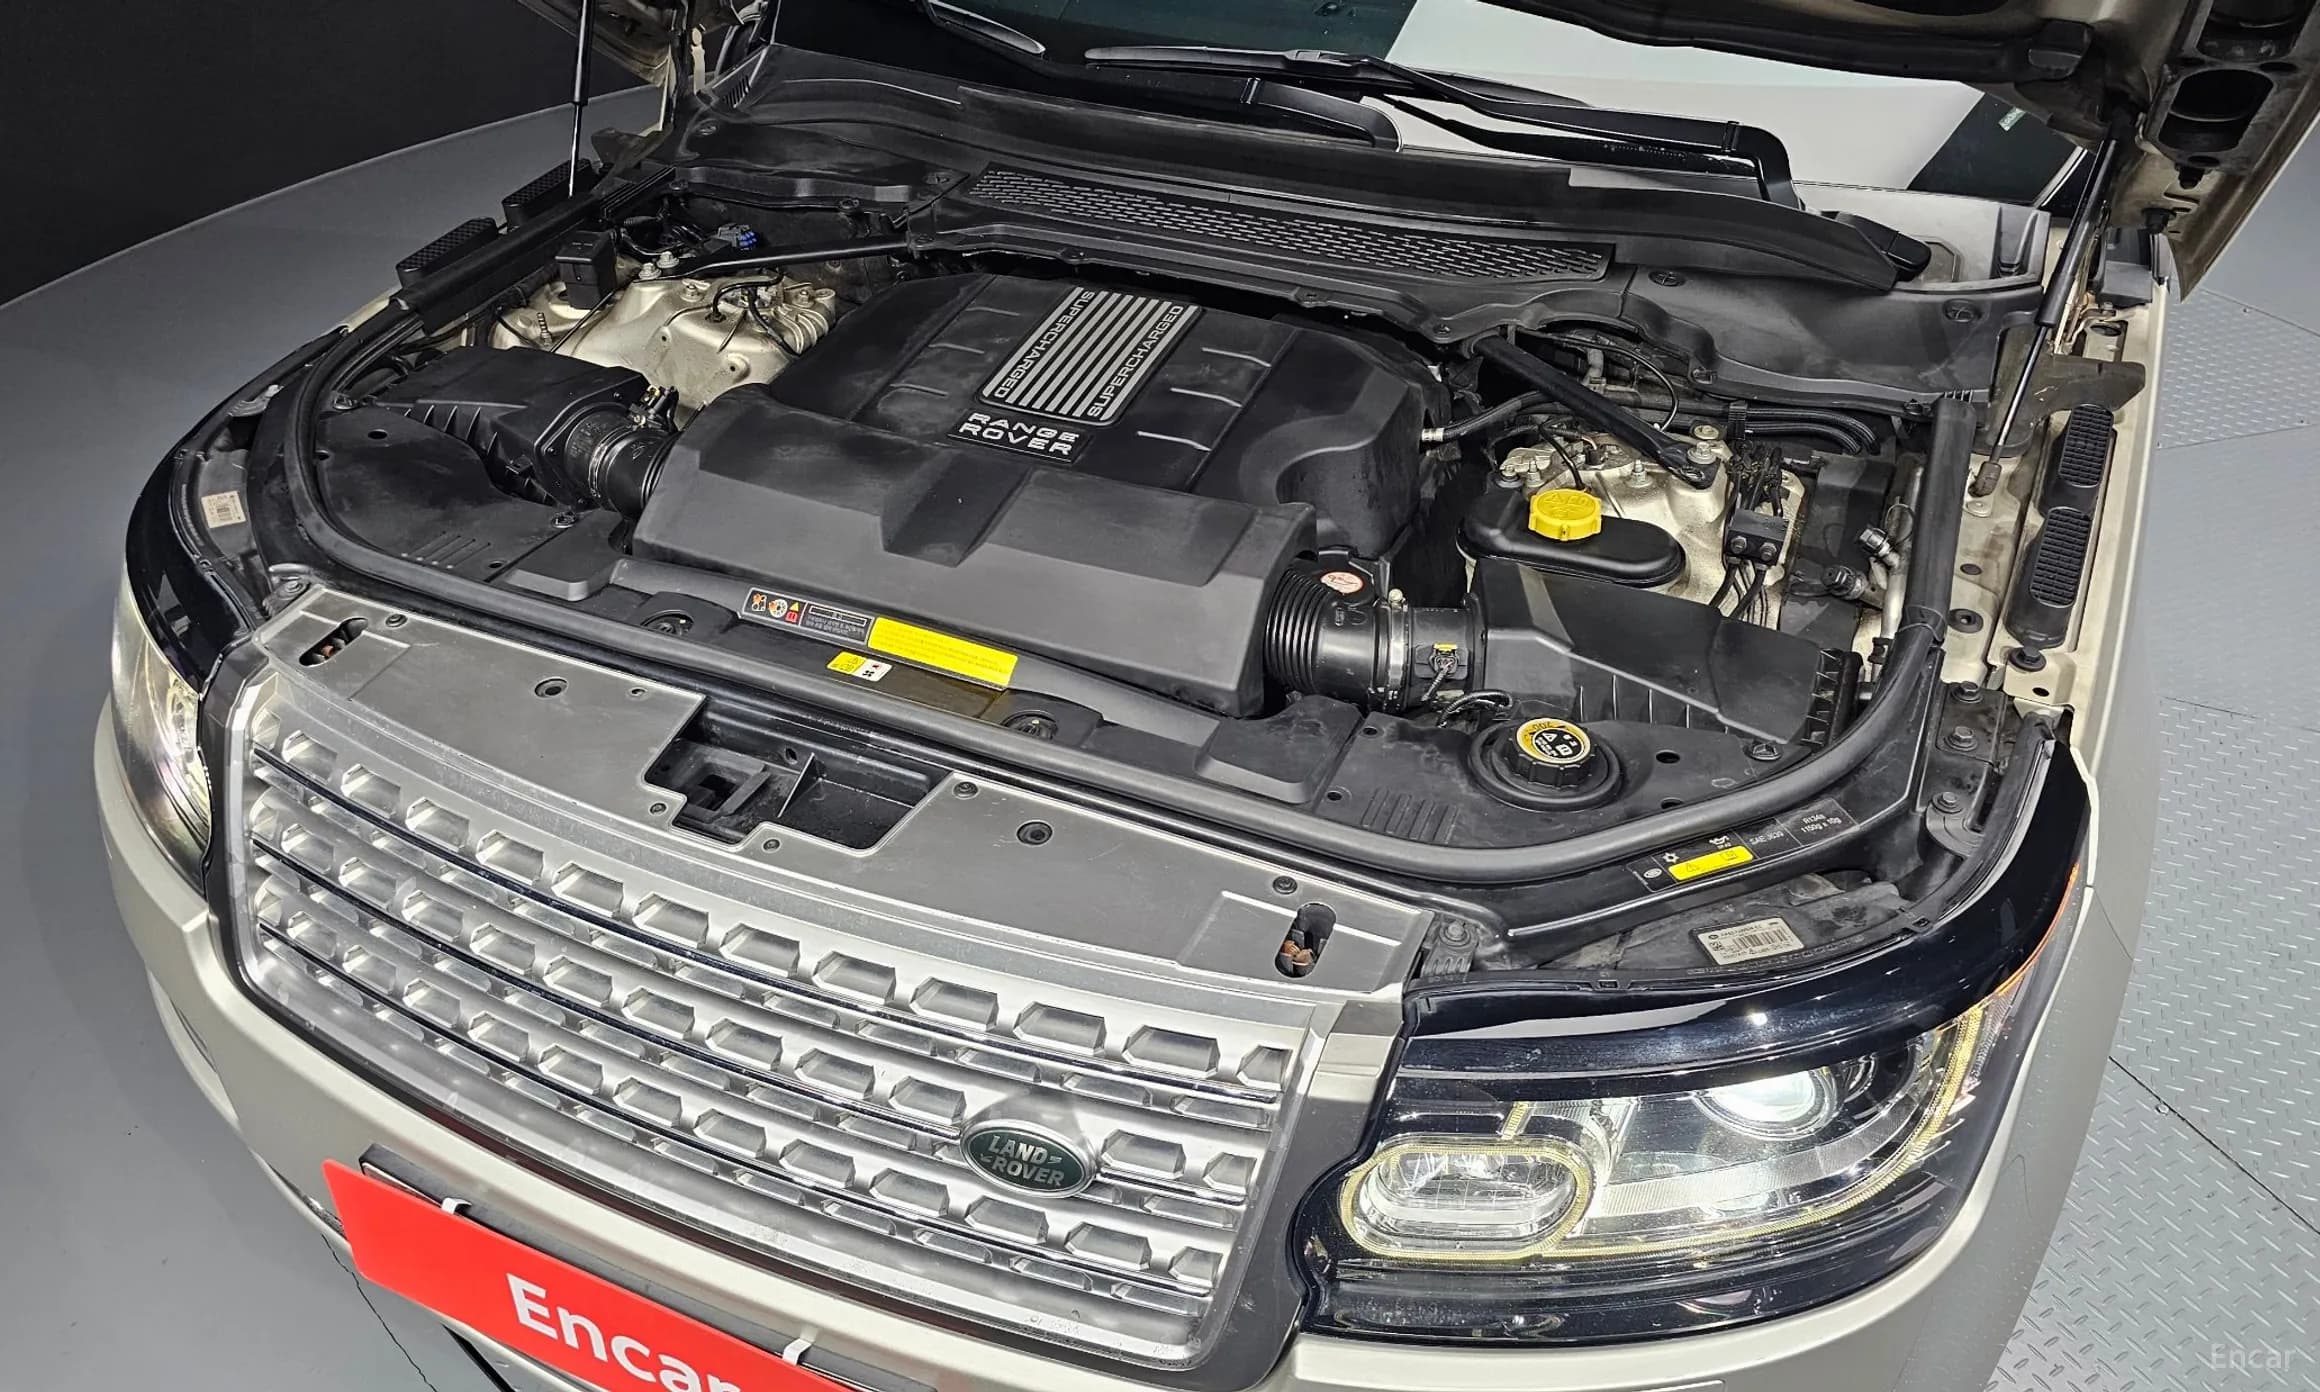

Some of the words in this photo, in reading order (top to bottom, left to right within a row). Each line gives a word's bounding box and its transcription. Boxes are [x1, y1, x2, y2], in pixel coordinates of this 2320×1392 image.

[994, 290, 1095, 399] SUPERCHARGED
[1086, 305, 1184, 417] SUPERCHARGED
[958, 422, 1073, 456] ROVER
[967, 412, 1080, 444] RANGE
[988, 1135, 1048, 1164] LAND
[991, 1155, 1065, 1187] ROVER
